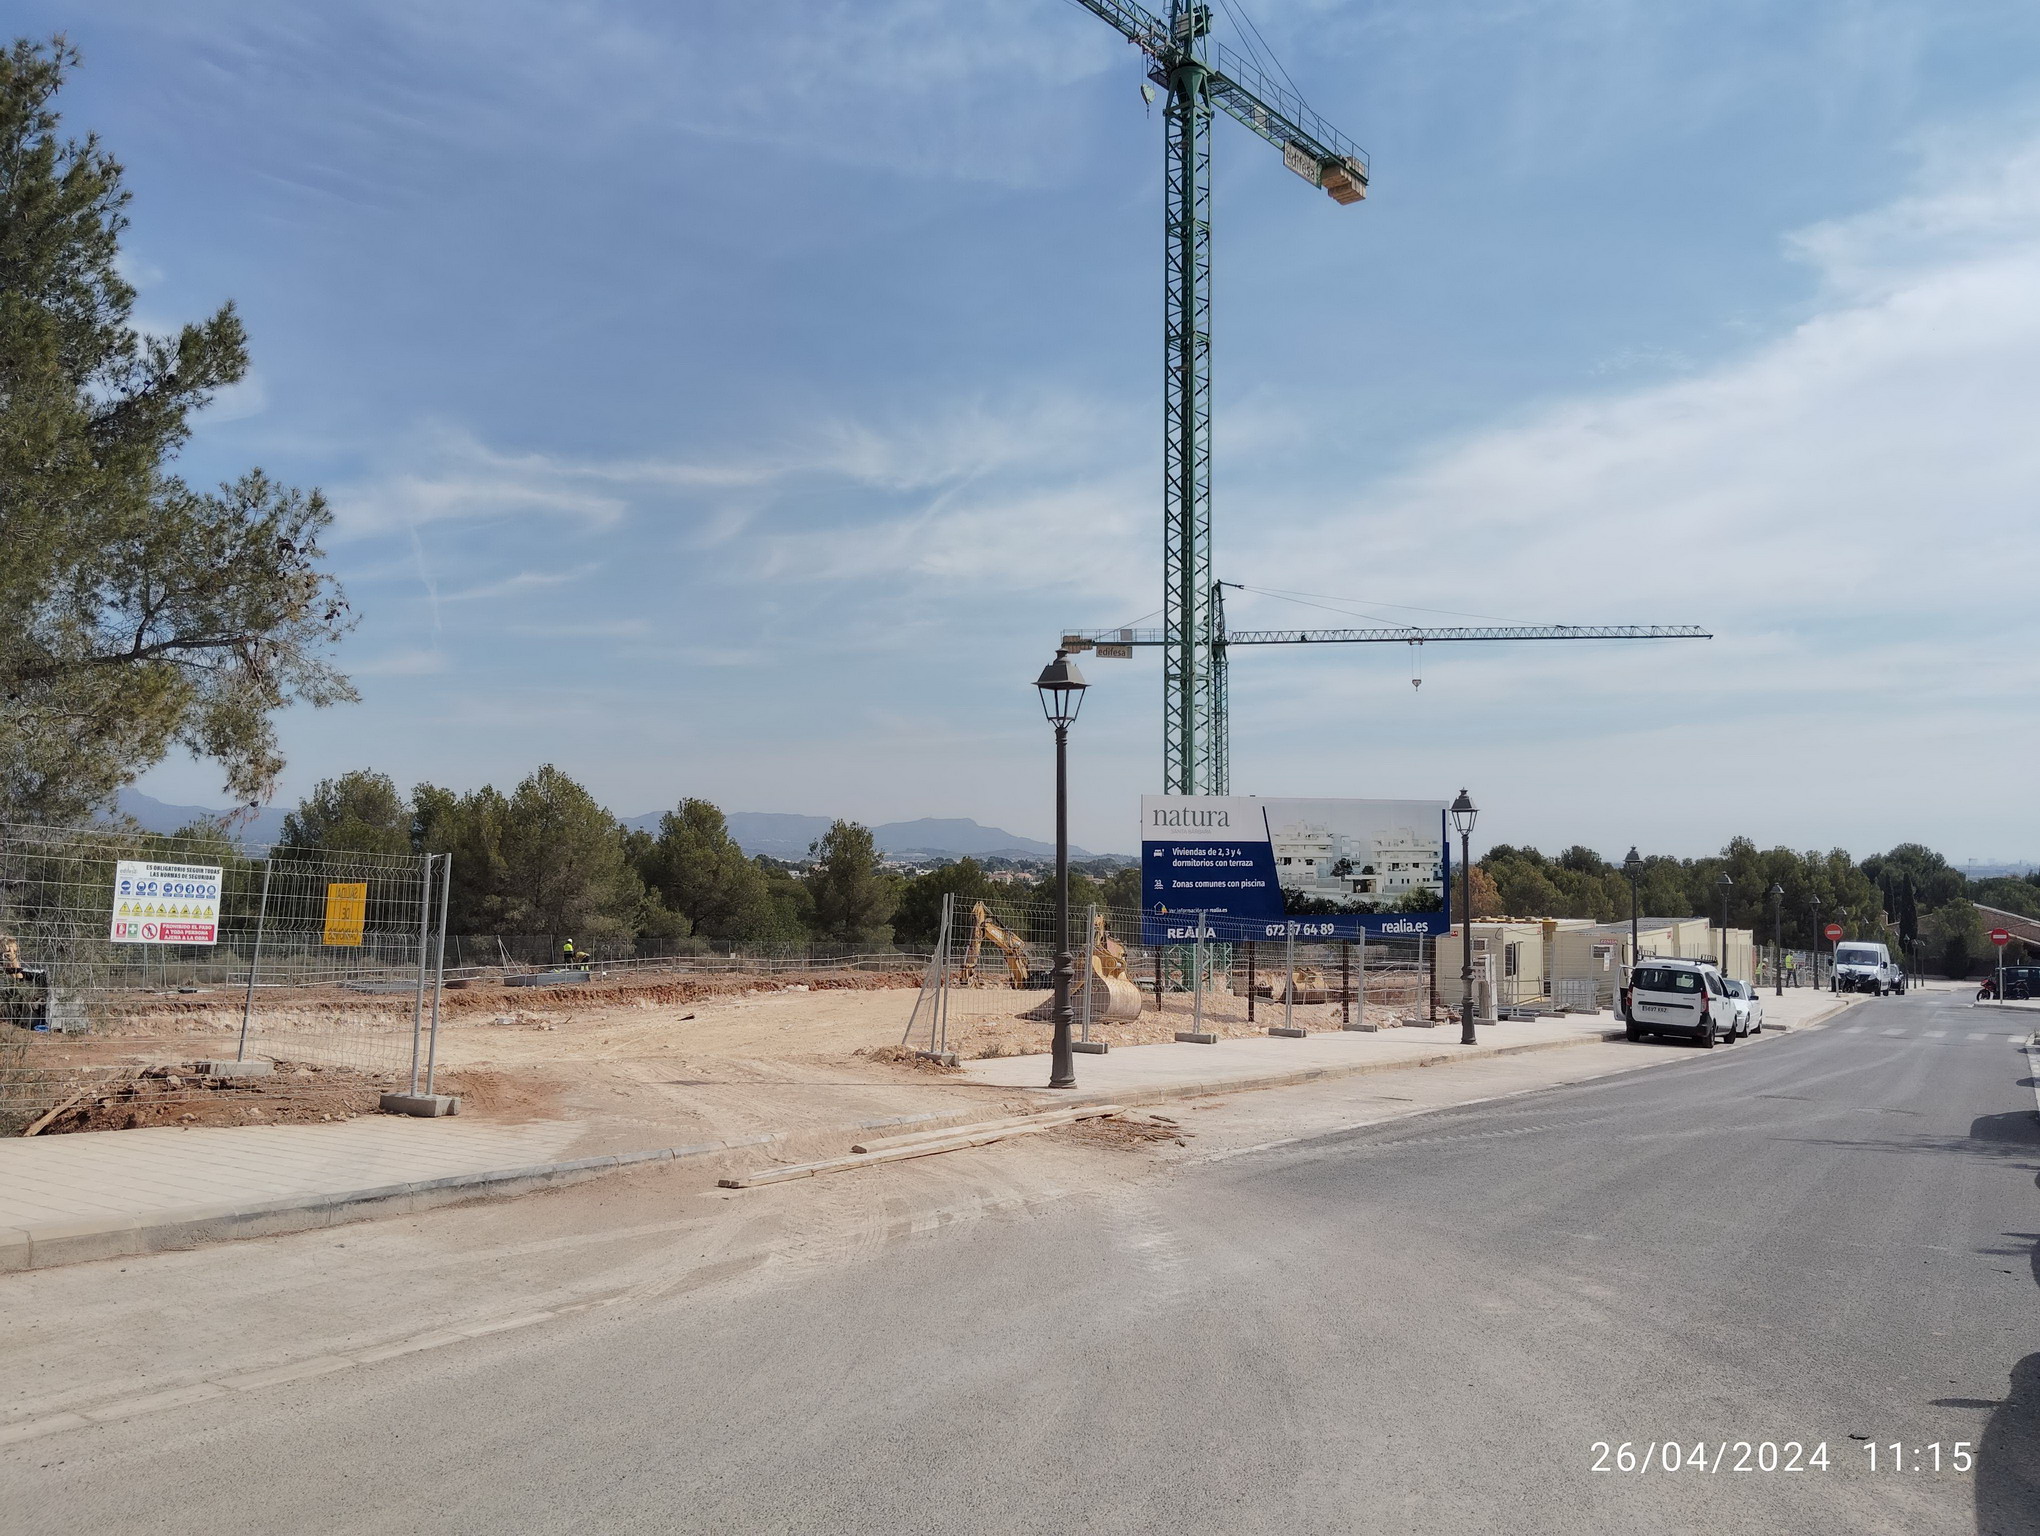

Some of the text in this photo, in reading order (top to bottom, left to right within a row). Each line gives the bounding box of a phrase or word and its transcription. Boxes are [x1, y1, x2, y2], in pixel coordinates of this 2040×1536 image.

[1286, 150, 1315, 180] edifesa
[1098, 647, 1126, 657] edifesa
[1152, 806, 1230, 827] natura
[1172, 847, 1206, 856] Viviendas
[1208, 848, 1216, 856] de
[1218, 848, 1224, 857] 2,
[1231, 850, 1236, 858] y
[1172, 858, 1214, 867] dormitorios
[1172, 880, 1193, 888] Zonas
[1241, 879, 1265, 889] piscina
[1266, 924, 1285, 936] 672
[1303, 924, 1318, 936] 64
[1320, 923, 1335, 935] 89
[1382, 918, 1428, 933] realia.es
